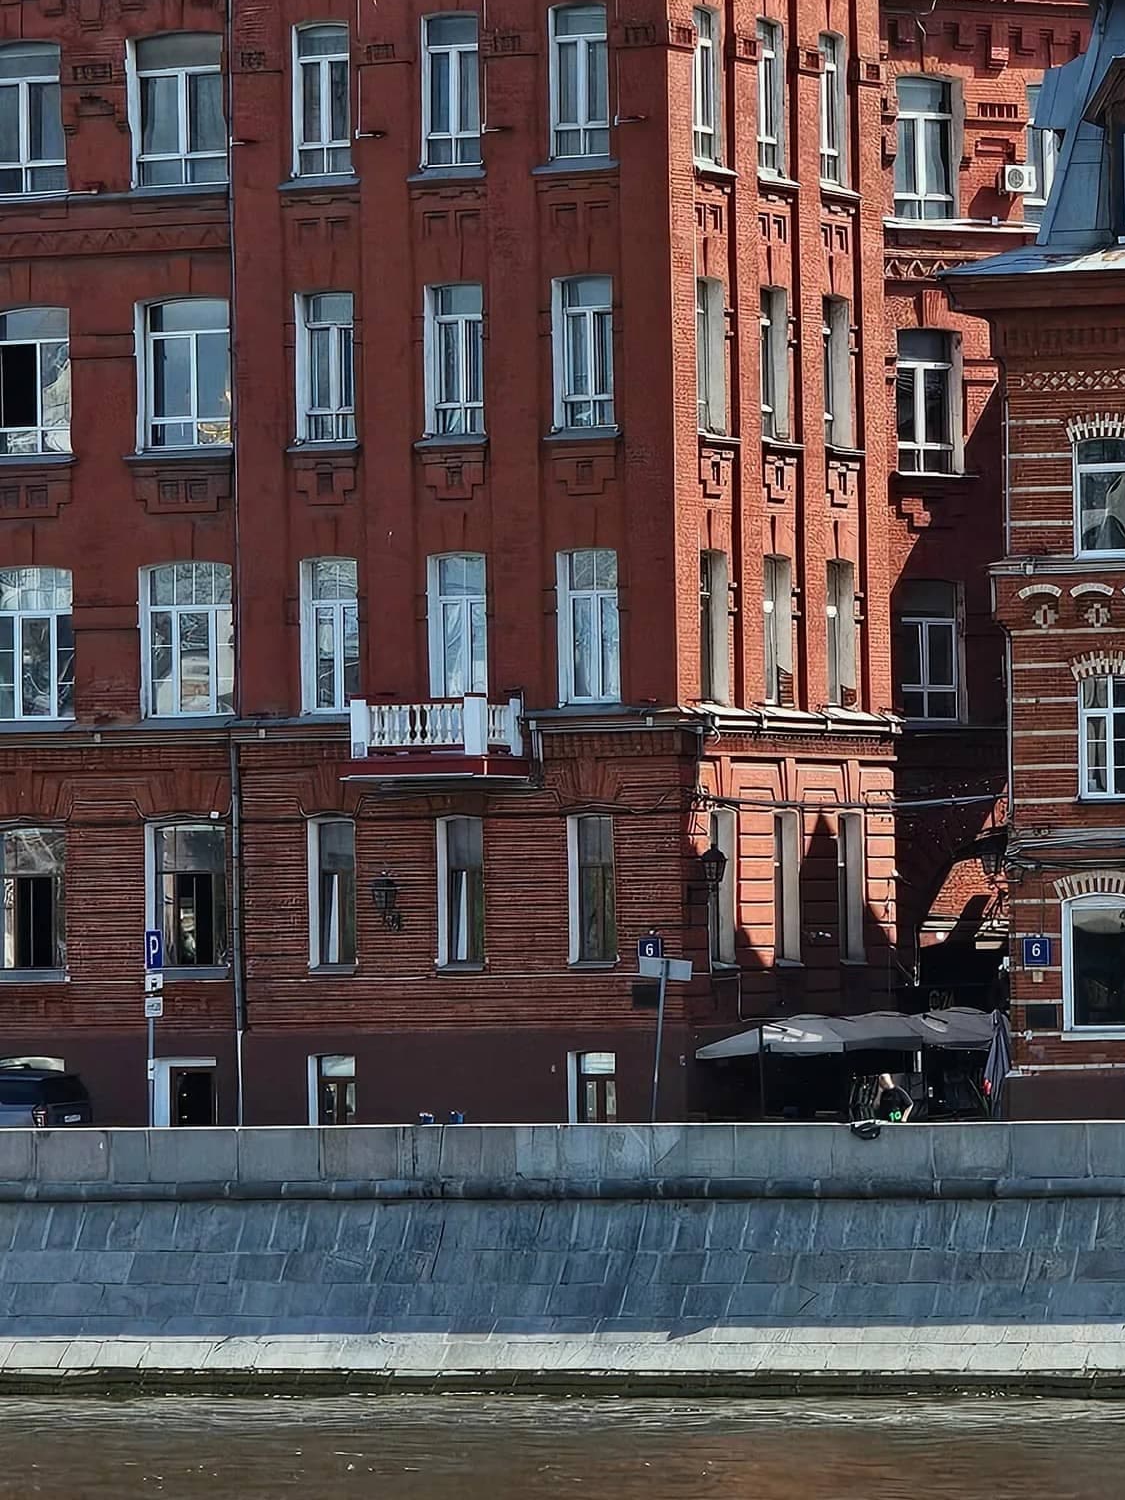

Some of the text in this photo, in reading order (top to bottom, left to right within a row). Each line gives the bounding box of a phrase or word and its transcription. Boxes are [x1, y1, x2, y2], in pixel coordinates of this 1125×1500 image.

[150, 935, 159, 965] P
[645, 943, 654, 957] 6
[1032, 943, 1041, 957] 6
